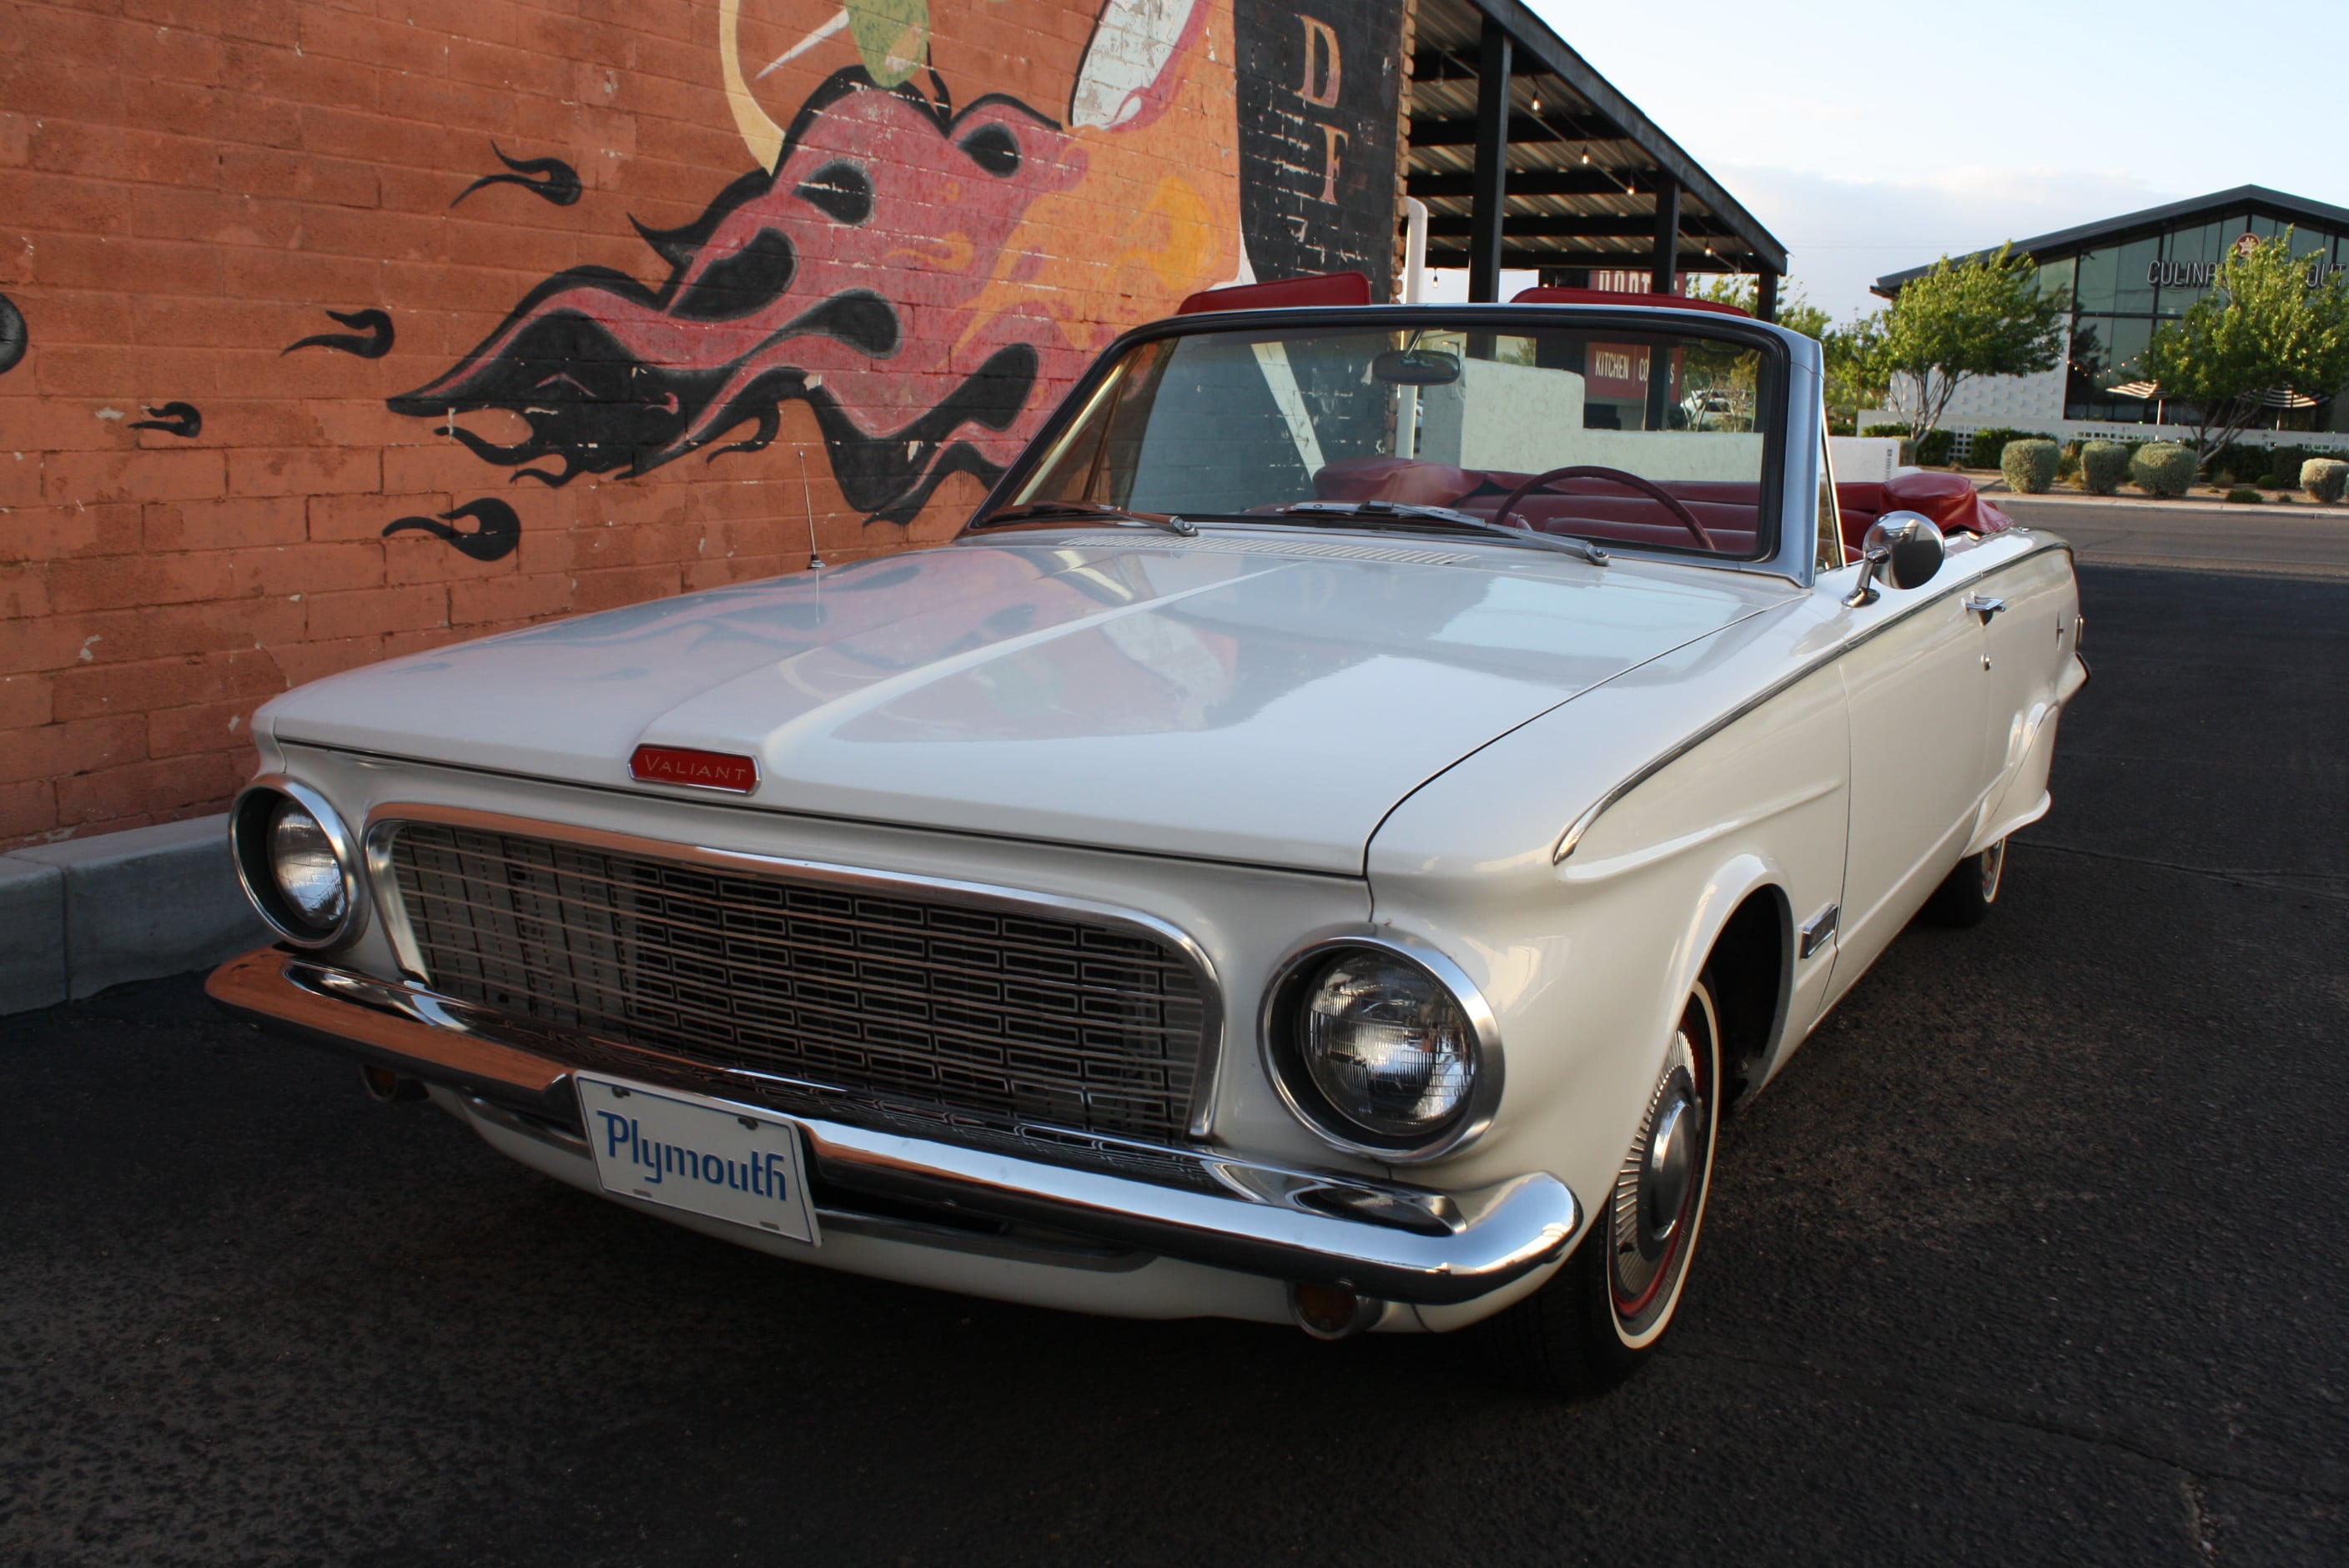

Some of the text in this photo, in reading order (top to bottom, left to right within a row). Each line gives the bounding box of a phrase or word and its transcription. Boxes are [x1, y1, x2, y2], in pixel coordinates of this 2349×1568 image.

[1595, 350, 1630, 379] KITCHEN
[645, 754, 747, 781] VALIANT
[596, 1108, 787, 1202] Plymouth
